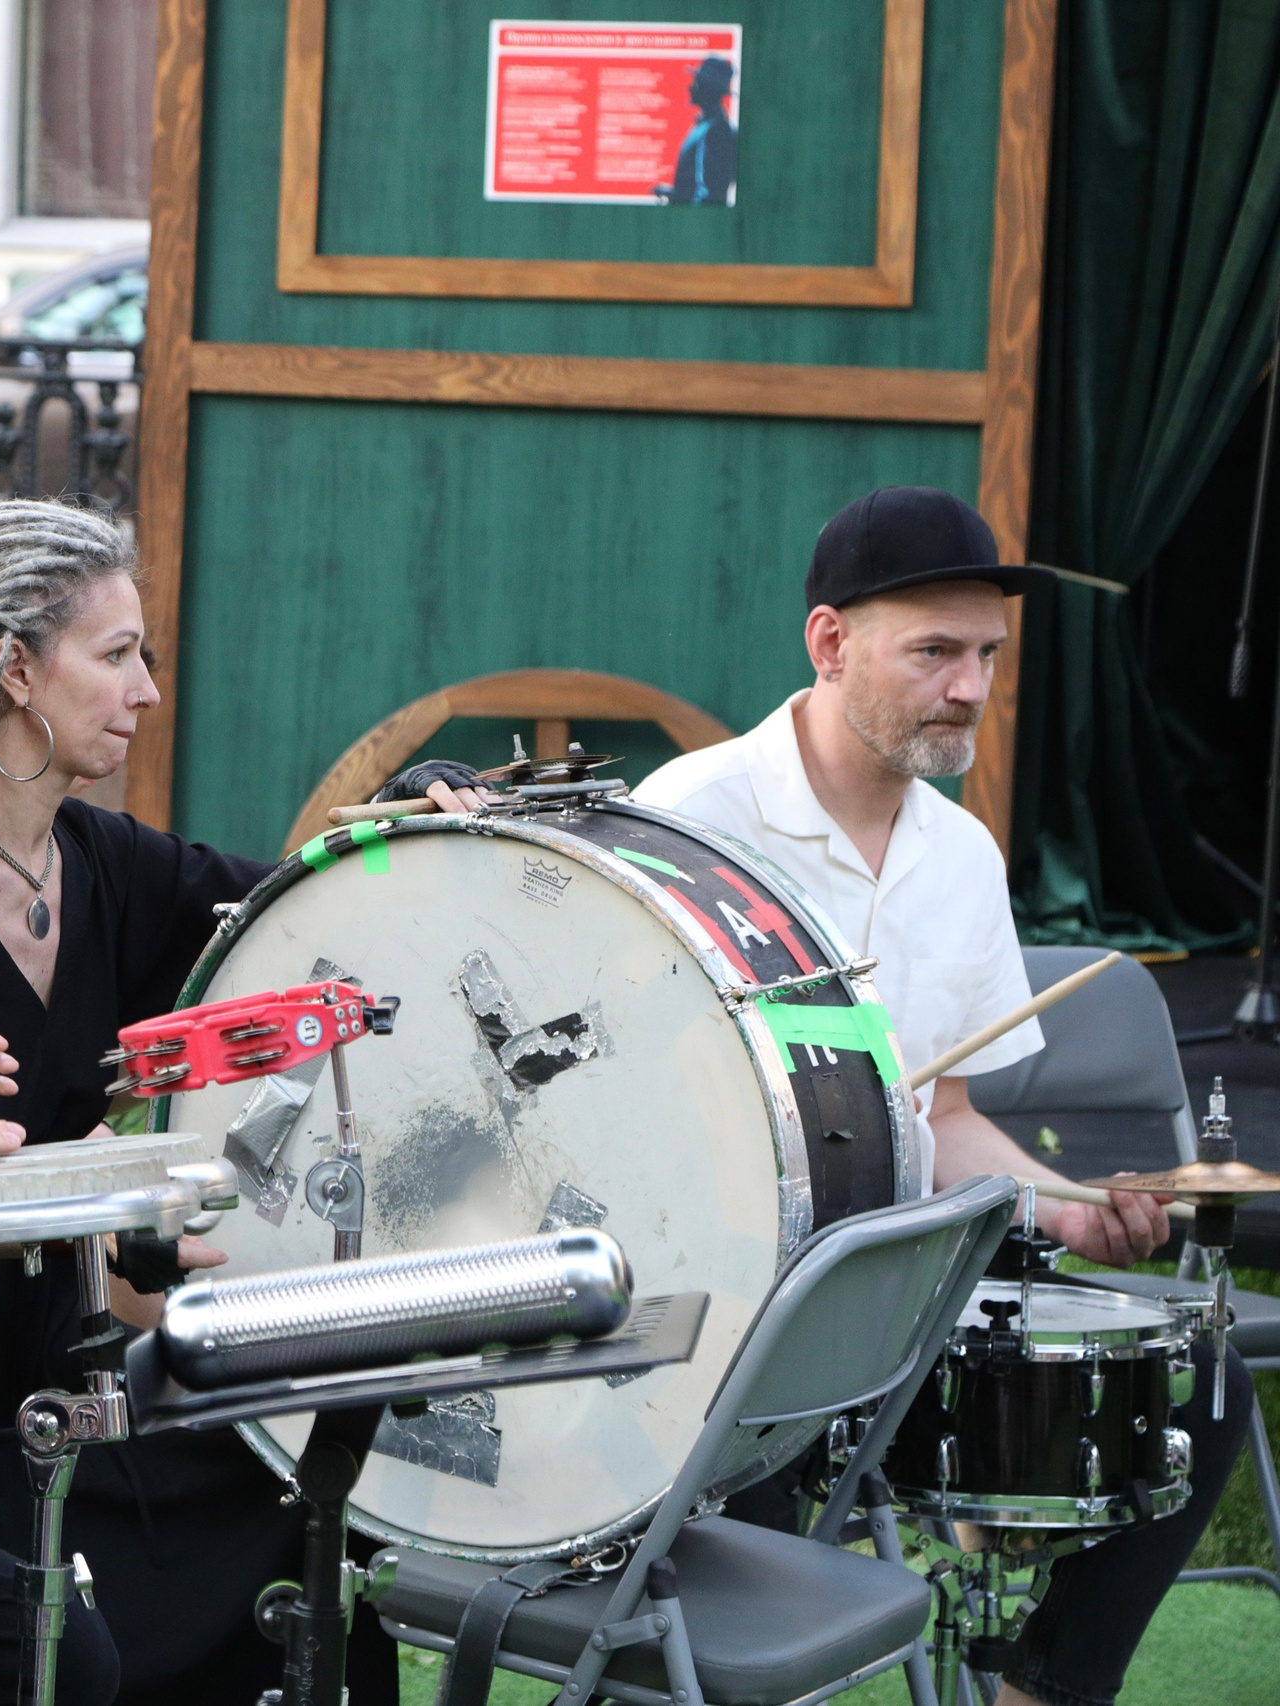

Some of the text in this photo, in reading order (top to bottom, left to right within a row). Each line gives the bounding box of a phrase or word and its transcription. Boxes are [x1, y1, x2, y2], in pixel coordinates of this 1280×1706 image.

[522, 875, 564, 897] WEATHER KING
[531, 867, 559, 884] REMO
[716, 900, 772, 949] A
